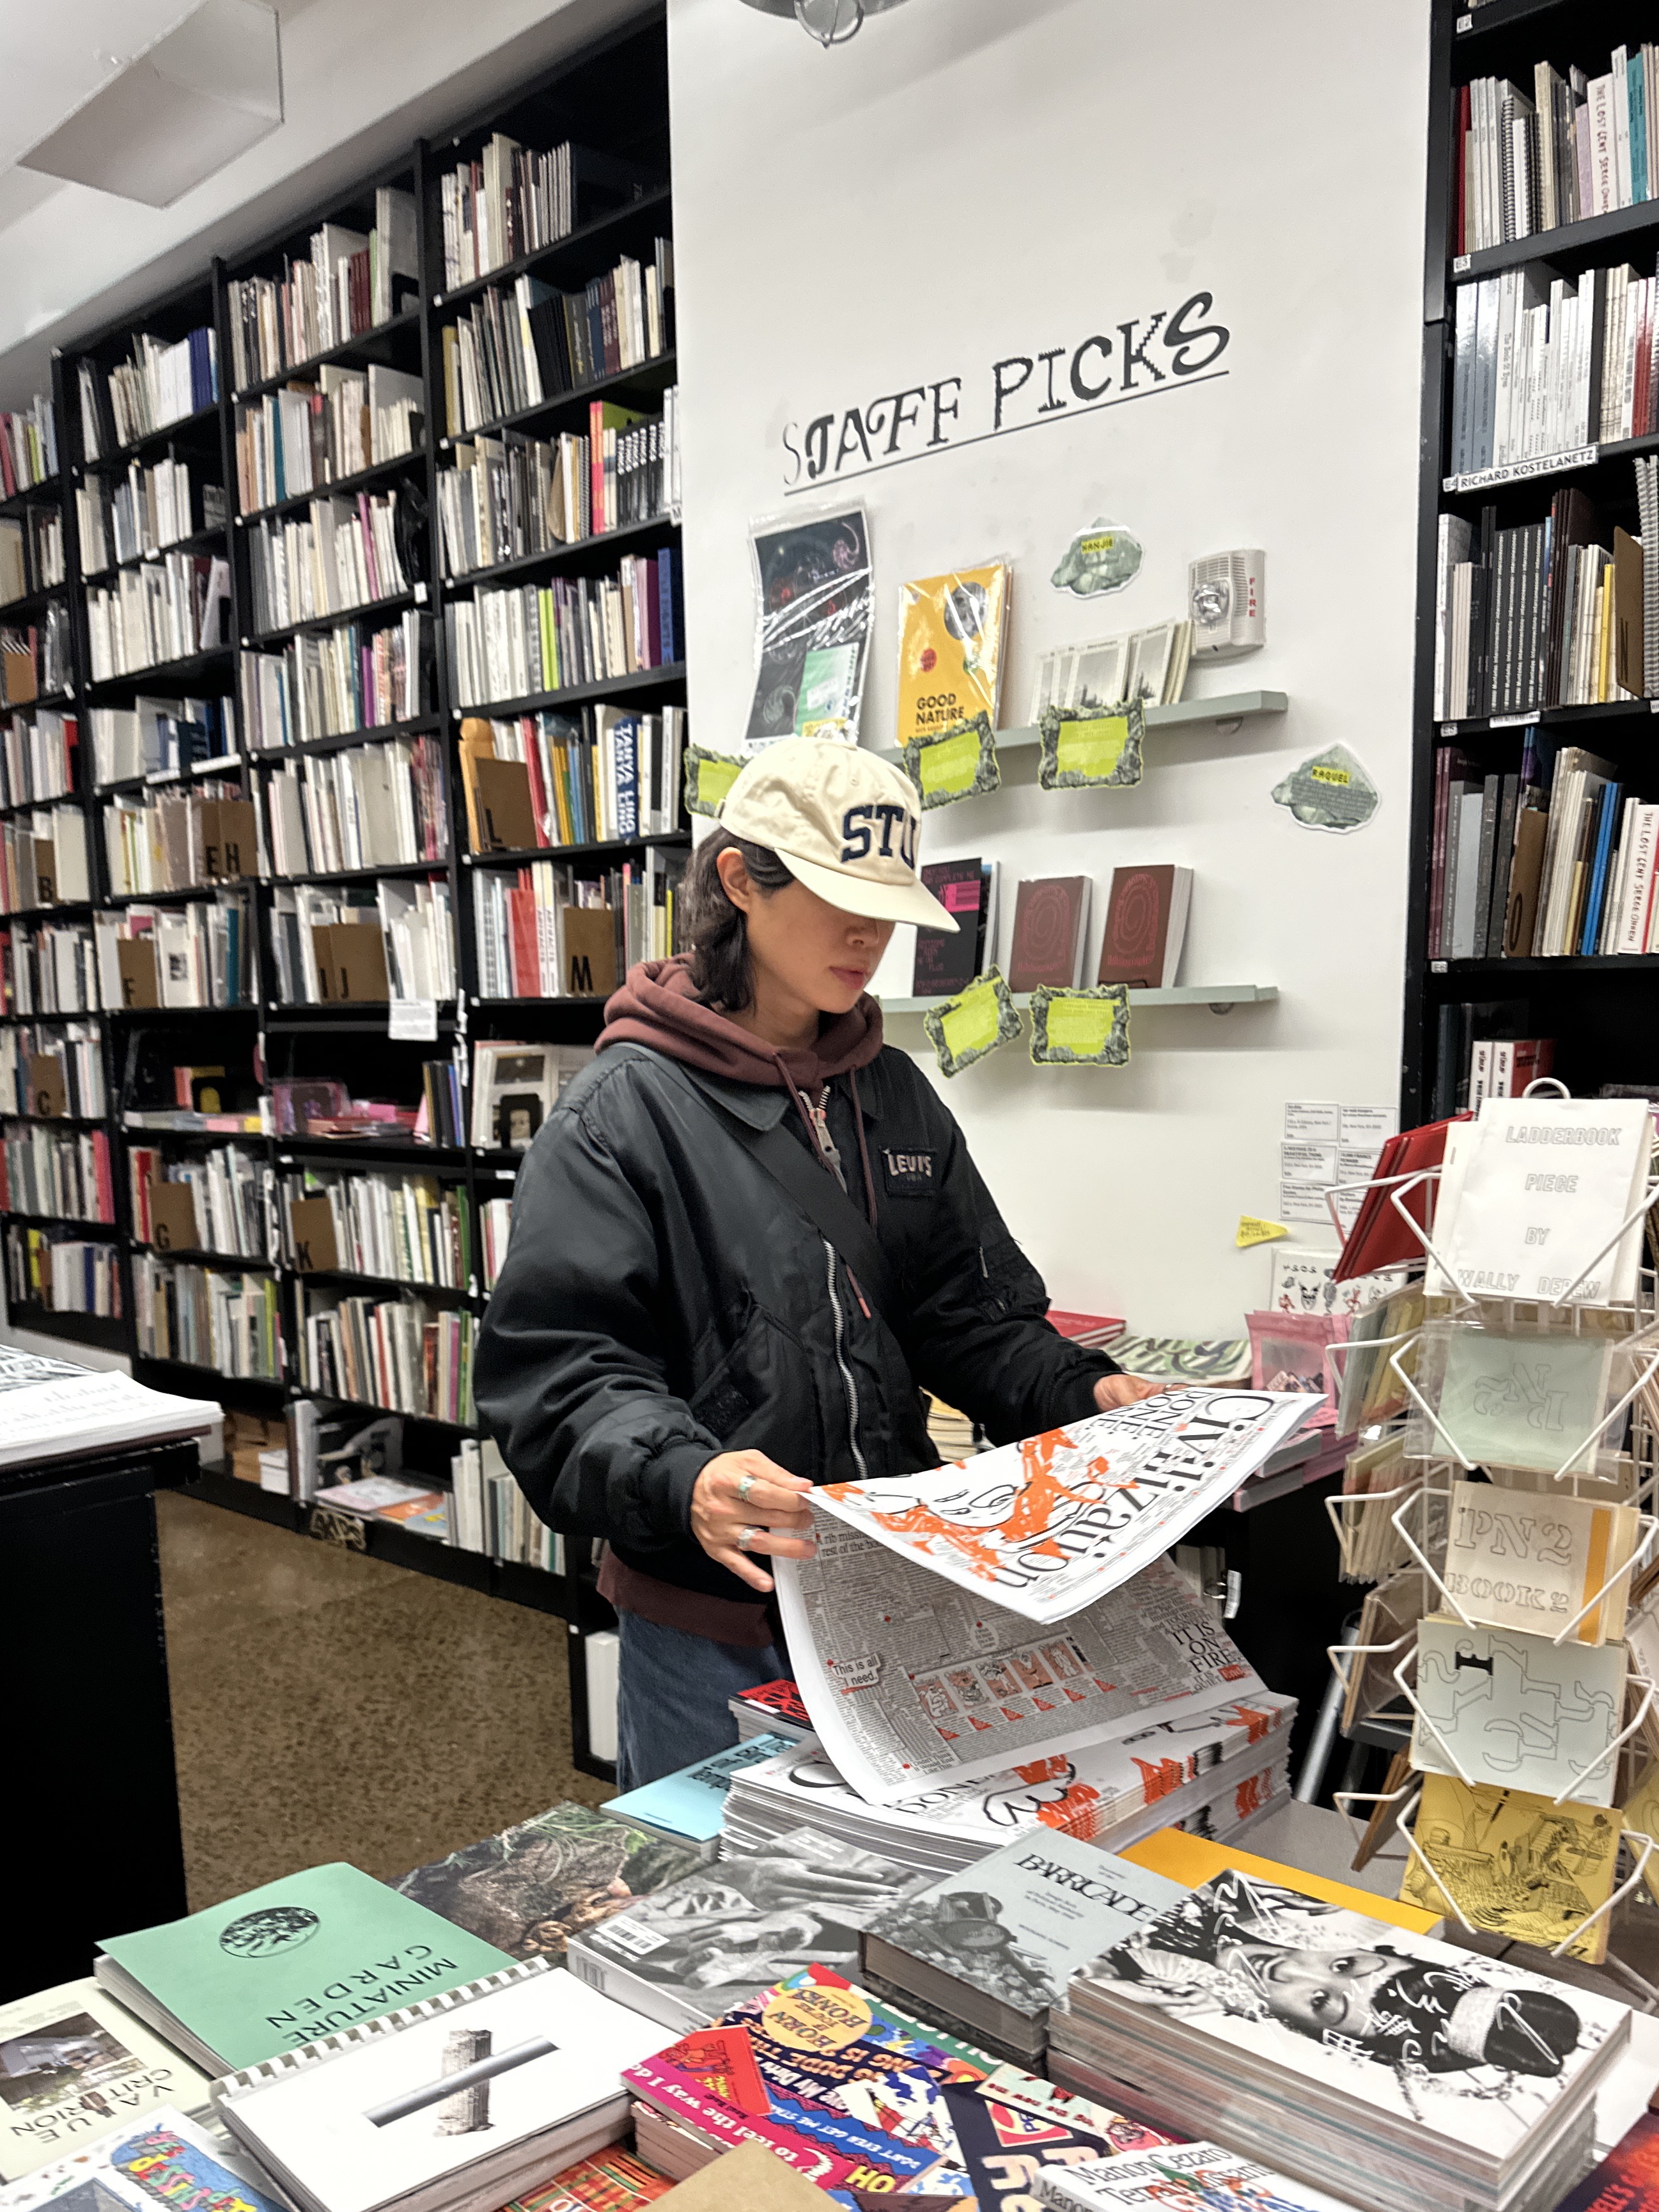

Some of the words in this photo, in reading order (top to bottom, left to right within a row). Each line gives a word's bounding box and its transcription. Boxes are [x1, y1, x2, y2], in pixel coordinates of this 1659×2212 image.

[783, 377, 962, 486] STAFF
[992, 291, 1230, 431] PICKS
[1460, 469, 1509, 487] RICHARD
[1513, 450, 1594, 476] KOSTELANETZ
[1249, 576, 1258, 618] FIRE
[917, 693, 956, 710] GOOD
[915, 706, 965, 726] NATURE
[1312, 768, 1349, 784] RAQUEL
[205, 846, 219, 877] E
[226, 843, 240, 872] H
[571, 955, 593, 992] M
[1505, 1125, 1623, 1147] LADDERBOOK
[1524, 1173, 1579, 1194] PIECE
[1524, 1226, 1551, 1245] BY
[1457, 1268, 1520, 1292] WALLY
[1172, 1627, 1195, 1646] IT
[1195, 1620, 1216, 1638] IS
[1188, 1637, 1222, 1656] ON
[833, 1662, 855, 1676] This
[855, 1660, 865, 1671] is
[866, 1655, 880, 1667] all
[1189, 1648, 1242, 1674] FIRE.
[1013, 1853, 1158, 1922] BARRICADE
[265, 1945, 433, 2028] GARDEN
[282, 1957, 458, 2047] MINIATURE
[663, 2083, 703, 2110] way
[793, 2076, 829, 2099] My
[702, 2108, 737, 2130] the
[774, 2145, 799, 2163] to
[1064, 2153, 1153, 2186] Manon
[1153, 2146, 1232, 2170] Cezaro
[845, 2165, 896, 2193] OH
